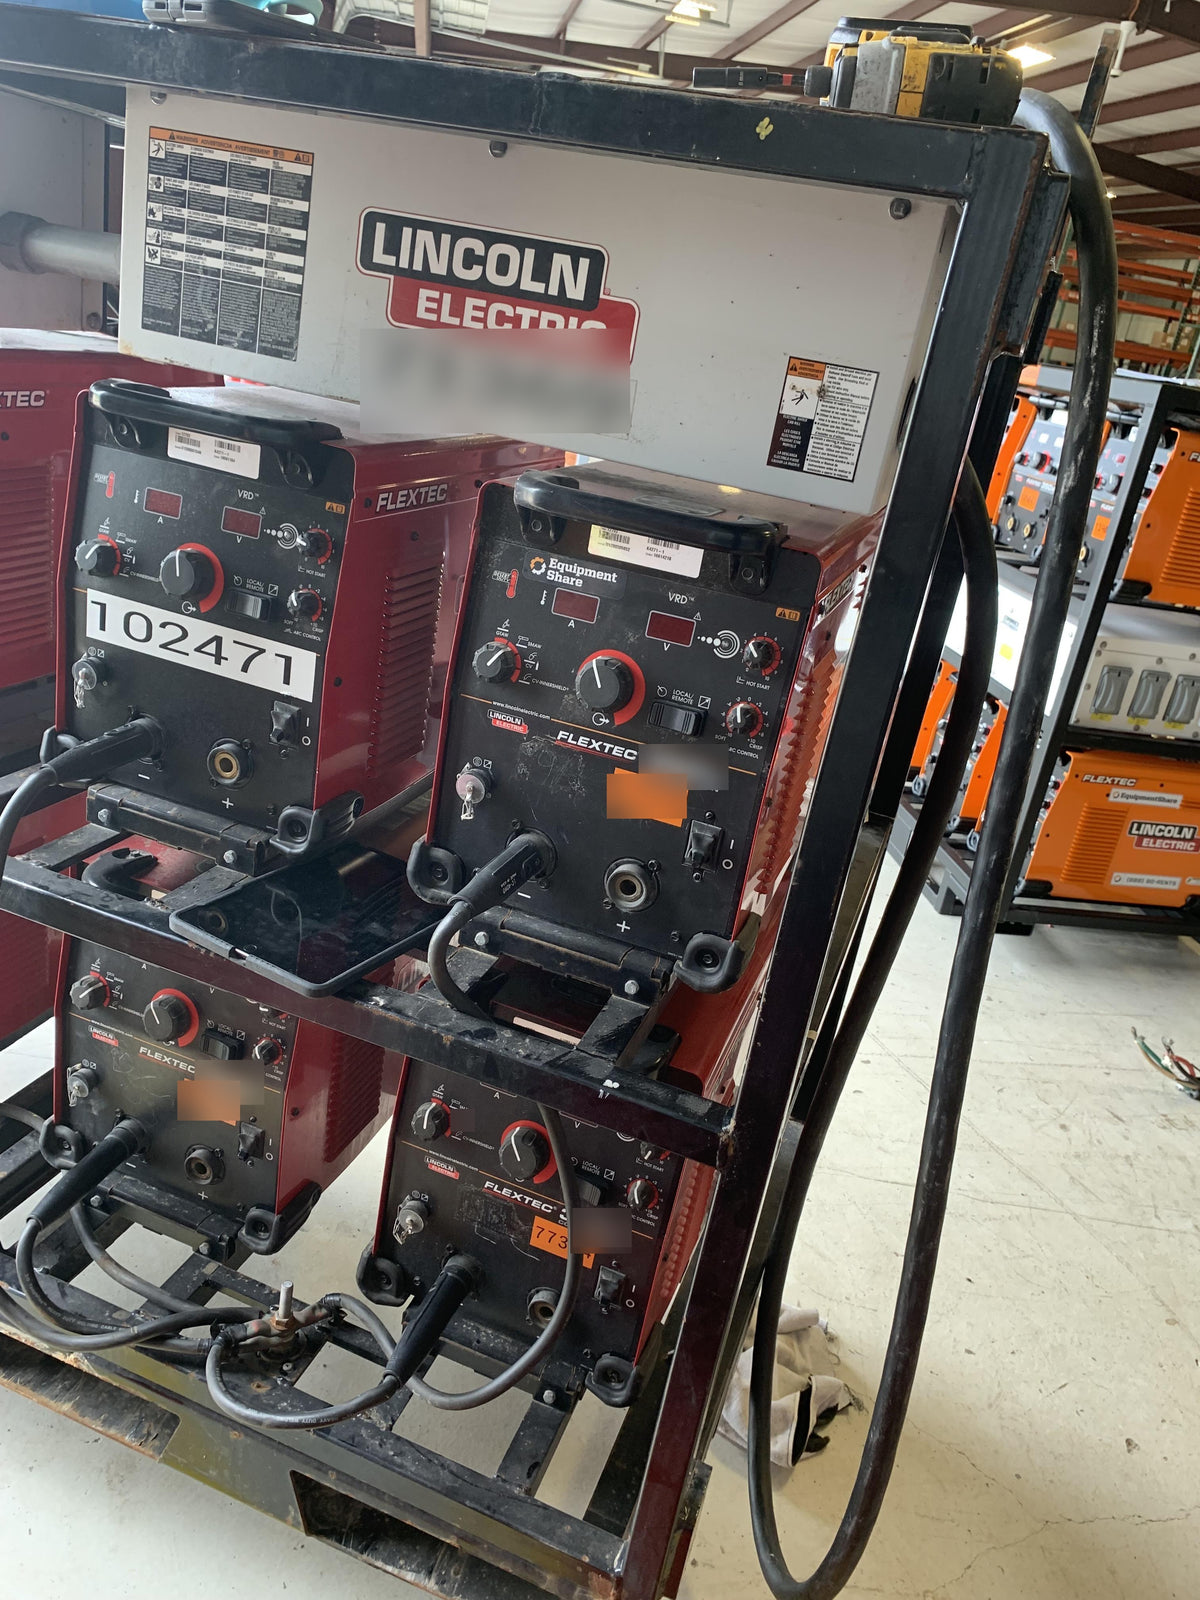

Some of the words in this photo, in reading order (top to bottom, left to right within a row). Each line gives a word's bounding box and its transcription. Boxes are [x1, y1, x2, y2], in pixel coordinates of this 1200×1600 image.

[372, 221, 590, 301] LINCOLN
[376, 483, 448, 512] FLEXTEC
[548, 557, 618, 583] Equipment
[546, 569, 584, 588] Share
[568, 620, 576, 629] A
[90, 600, 293, 686] 102471
[663, 642, 671, 652] V
[745, 680, 756, 688] HOT
[756, 682, 770, 690] START
[672, 688, 694, 699] LOCAL/
[672, 694, 694, 706] REMOTE
[492, 700, 550, 720] www.lincolnelectric.com
[489, 711, 522, 725] LINCOLN
[496, 719, 525, 732] ELECTRIC
[556, 730, 638, 761] FLEXTEC
[736, 748, 759, 760] CONTROL
[1082, 774, 1136, 787] FLEXTEC
[1130, 822, 1194, 840] LINCOLN
[1142, 838, 1196, 850] ELECTRIC
[139, 1046, 196, 1074] FLEXTEC
[494, 1092, 500, 1100] A
[574, 1121, 580, 1129] V
[426, 1156, 454, 1172] LINCOLN
[582, 1160, 601, 1170] LOCAL/
[582, 1165, 600, 1176] REMOTE
[484, 1180, 553, 1213] FLEXTEC
